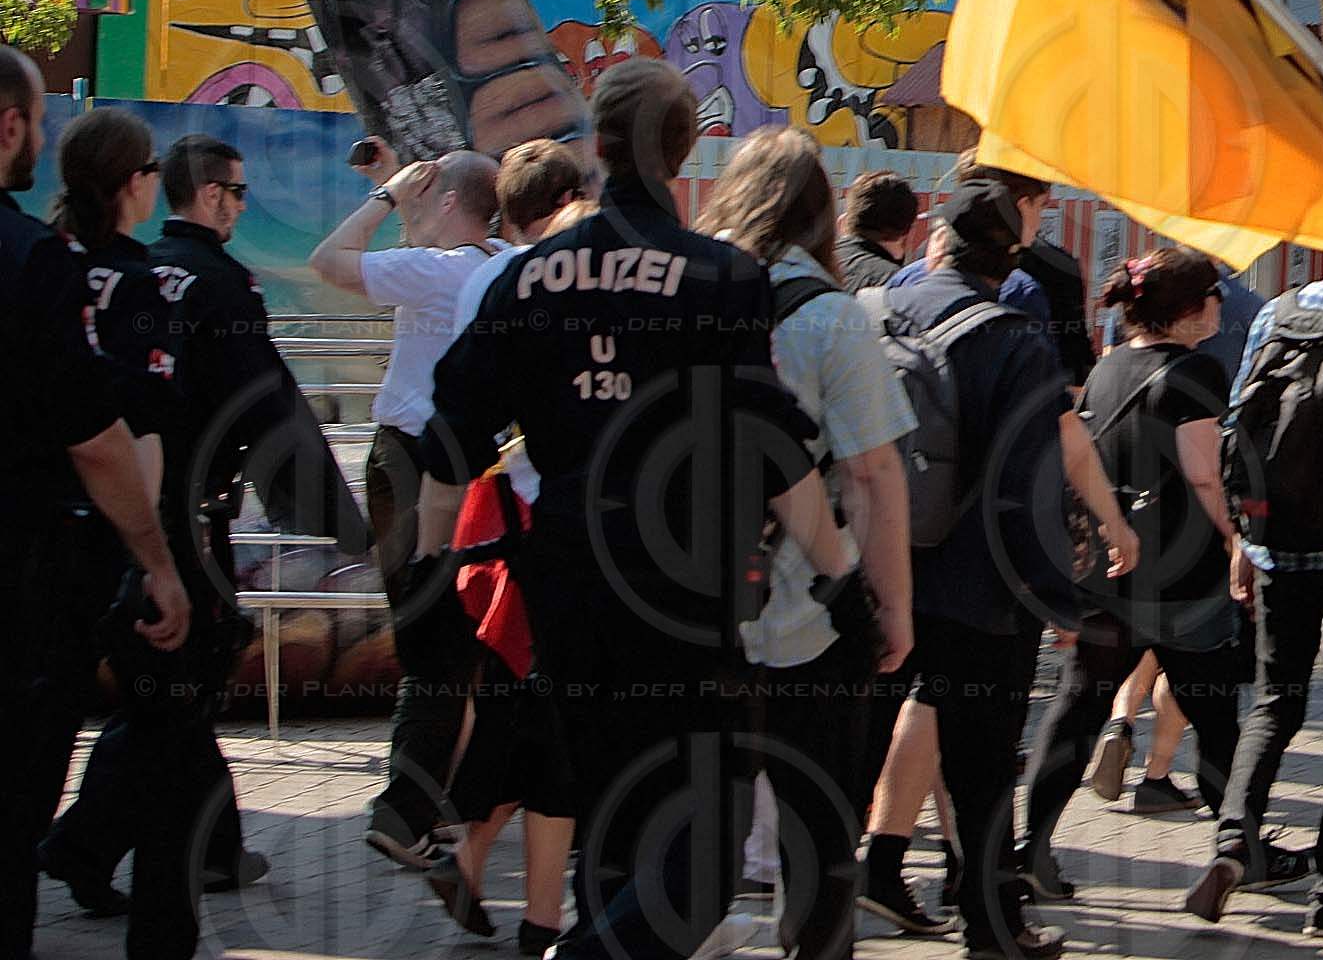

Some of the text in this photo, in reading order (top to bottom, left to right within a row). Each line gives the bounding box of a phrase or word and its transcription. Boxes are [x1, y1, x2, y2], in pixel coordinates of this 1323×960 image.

[517, 247, 687, 300] POLIZEI
[590, 335, 616, 363] U
[572, 370, 632, 401] 130
